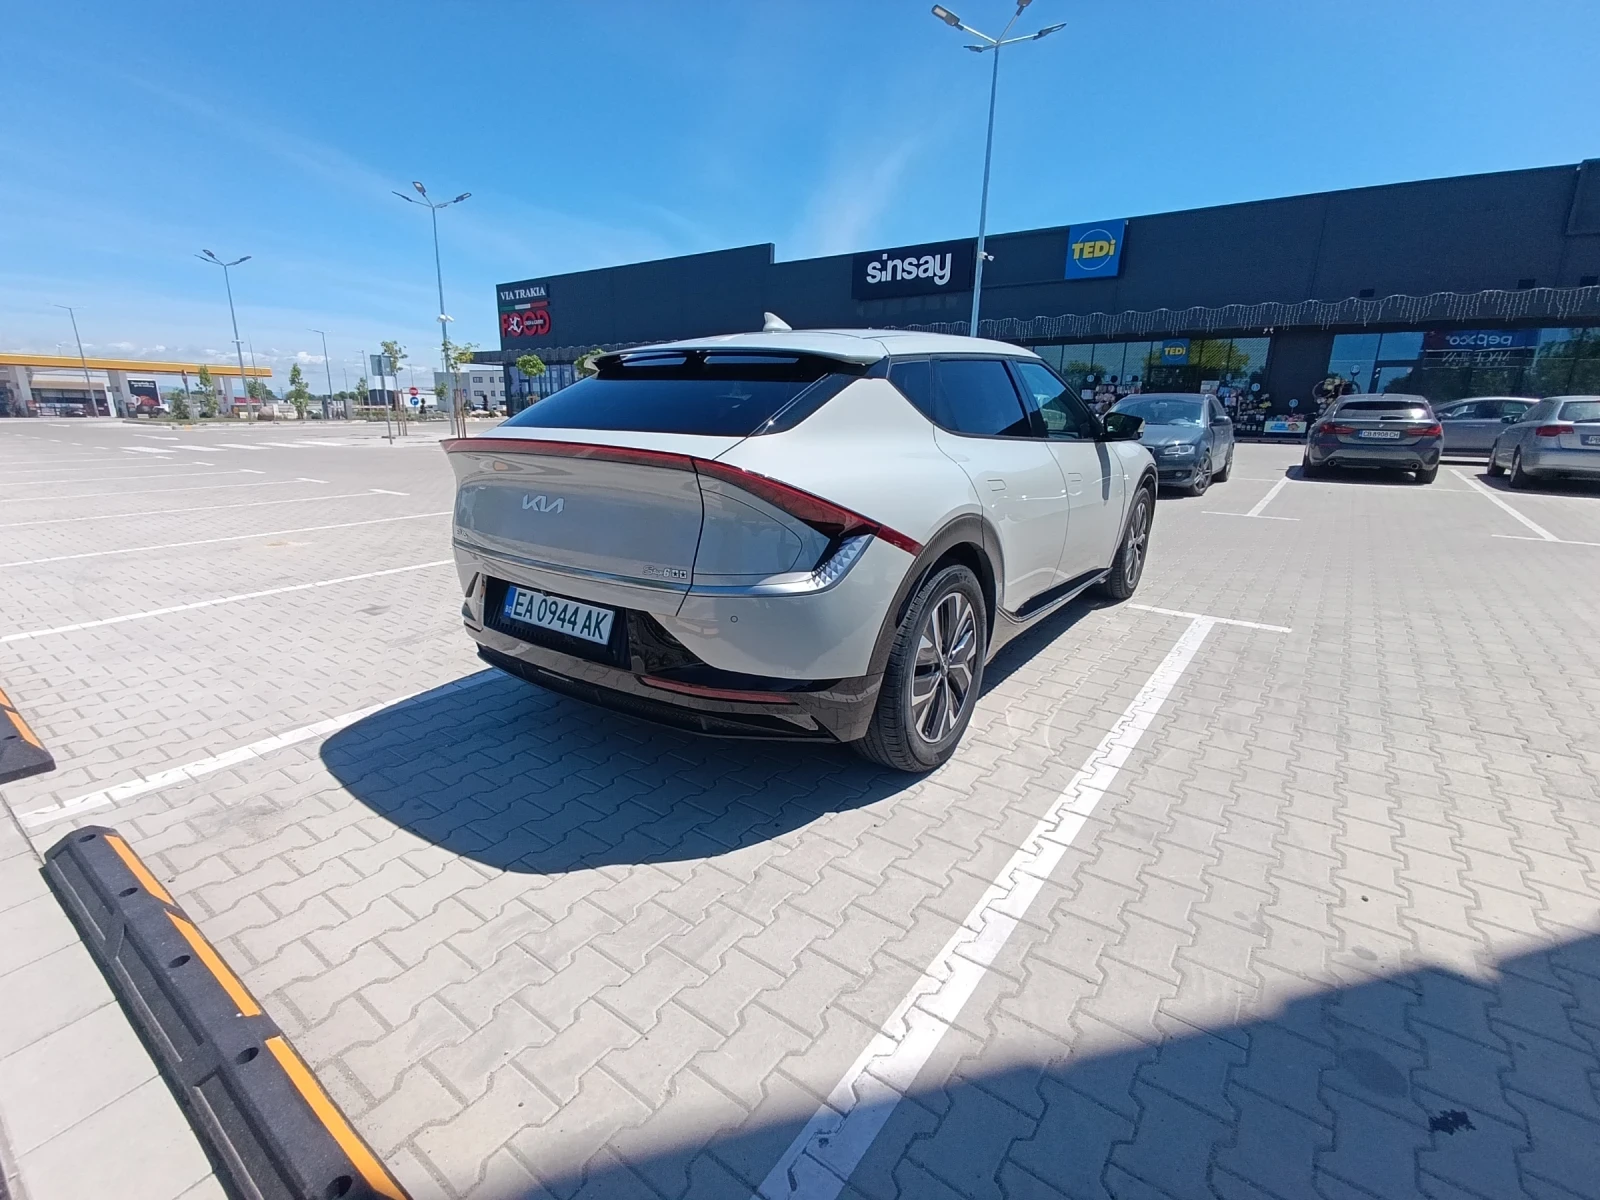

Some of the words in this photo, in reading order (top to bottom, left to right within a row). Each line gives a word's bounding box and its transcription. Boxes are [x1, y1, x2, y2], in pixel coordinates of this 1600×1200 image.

[1072, 239, 1116, 260] TEDi
[866, 253, 952, 286] sinsay
[500, 291, 515, 301] VIA
[514, 287, 546, 299] TRAKIA
[501, 309, 551, 338] FOOD
[522, 494, 564, 514] KIA
[513, 591, 534, 620] EA
[537, 598, 580, 632] 0944
[580, 609, 608, 640] AK
